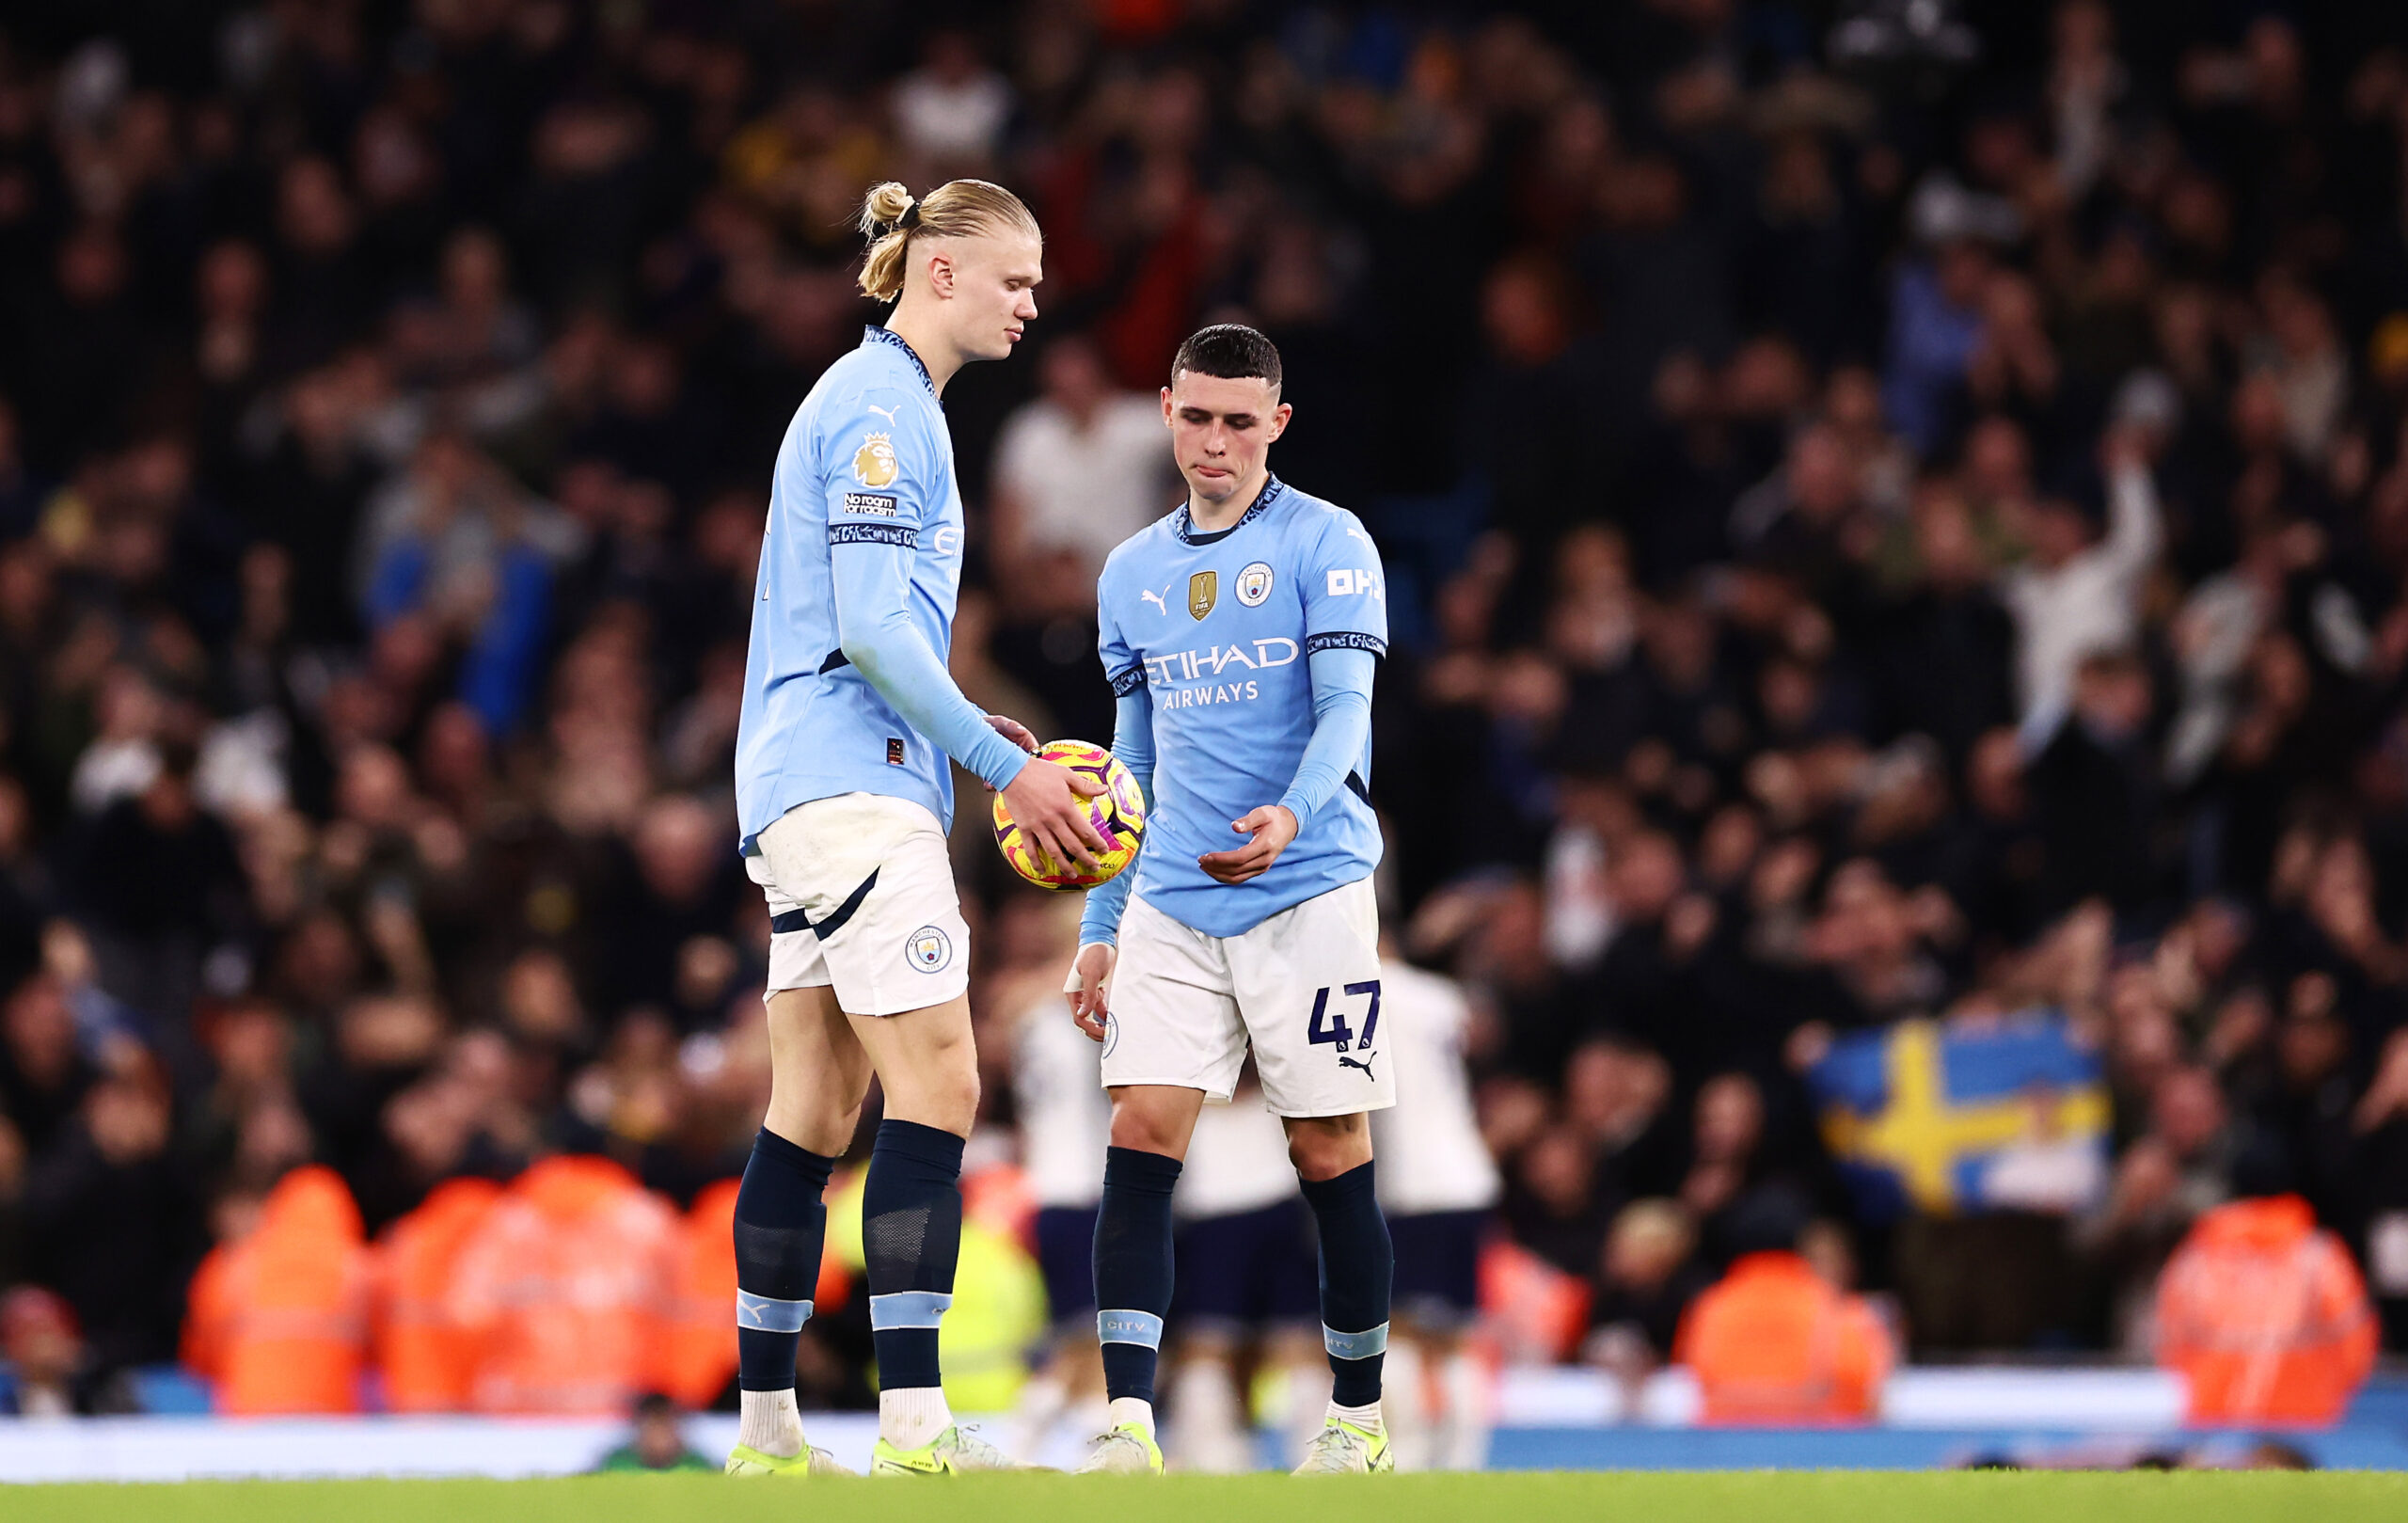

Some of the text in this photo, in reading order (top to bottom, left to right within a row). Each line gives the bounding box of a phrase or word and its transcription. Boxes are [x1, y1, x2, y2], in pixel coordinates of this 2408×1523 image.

[844, 493, 893, 508] No room
[860, 505, 895, 517] racism
[1143, 637, 1299, 685] ETIHAD
[1163, 680, 1259, 711] AIRWAYS
[1307, 979, 1381, 1053] 47
[1106, 1320, 1145, 1332] CITY
